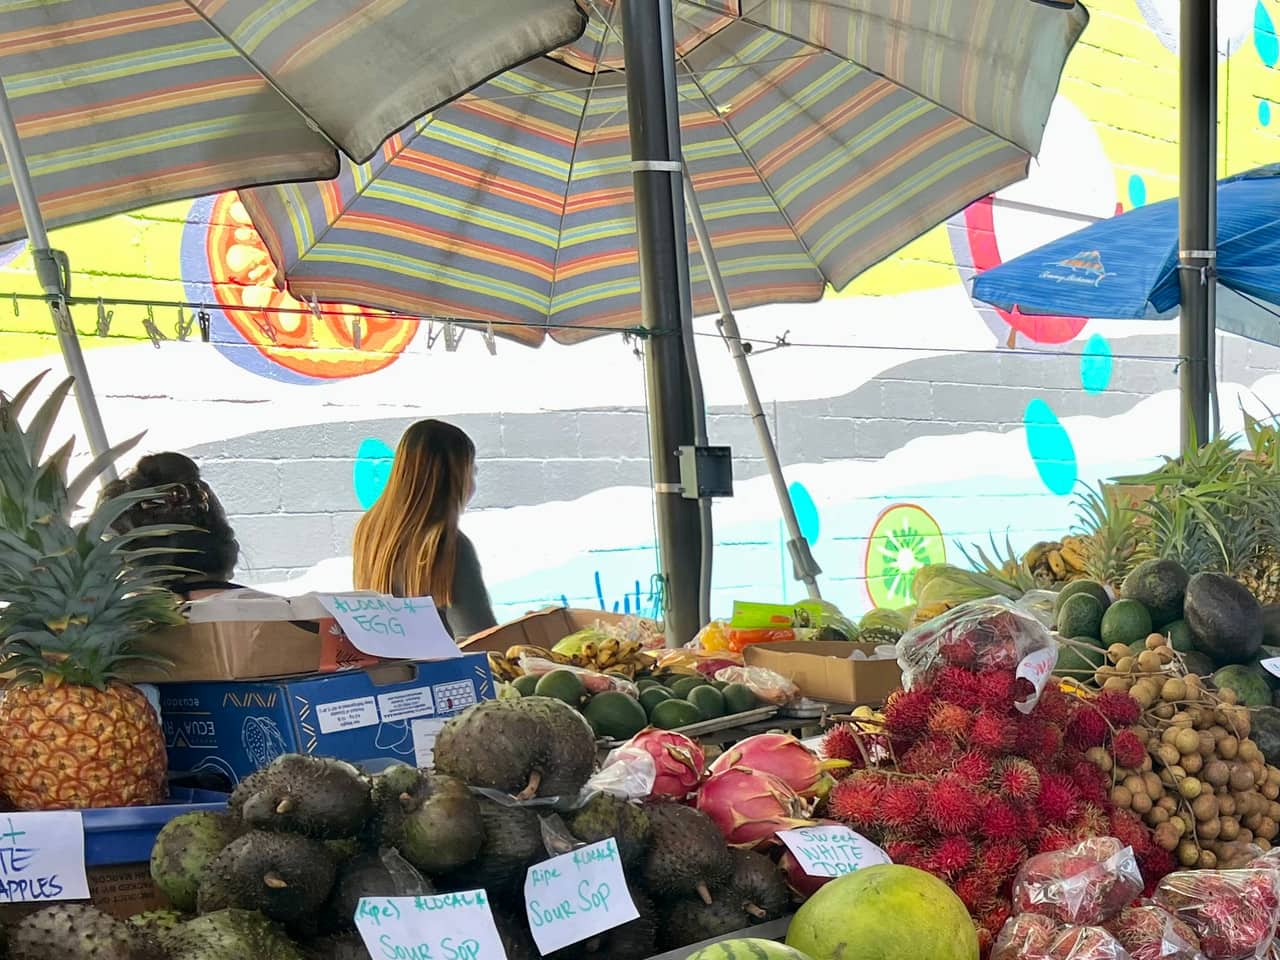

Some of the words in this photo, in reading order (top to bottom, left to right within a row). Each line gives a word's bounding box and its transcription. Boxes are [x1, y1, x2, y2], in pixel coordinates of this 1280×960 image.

[352, 614, 406, 637] EGG
[797, 844, 864, 861] WHITE
[532, 868, 562, 887] Ripe
